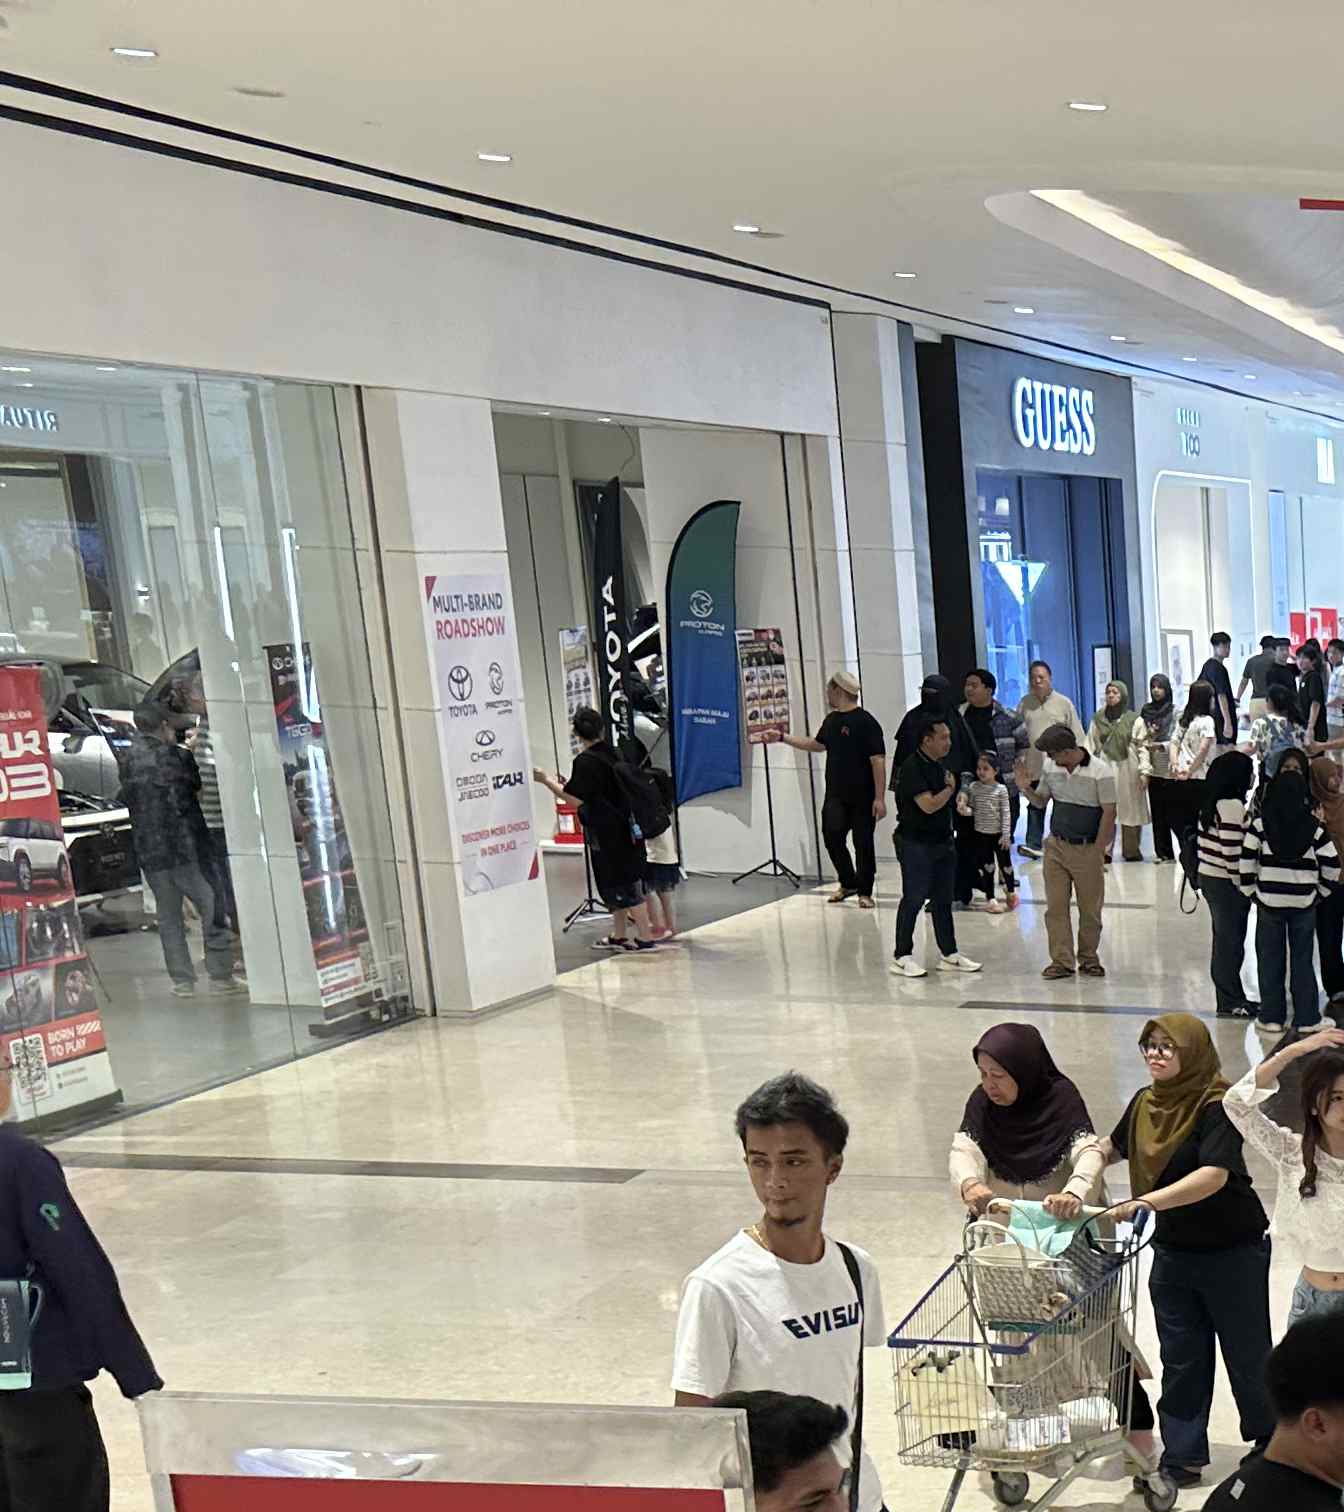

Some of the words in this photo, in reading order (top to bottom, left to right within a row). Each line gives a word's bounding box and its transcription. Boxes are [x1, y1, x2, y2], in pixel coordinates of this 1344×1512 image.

[1013, 376, 1096, 456] GUESS
[433, 593, 503, 613] MULTI-BRAND
[436, 616, 505, 640] ROADSHOW
[680, 620, 725, 631] PROTON
[601, 575, 629, 748] TOYOTA
[448, 704, 478, 718] TOYOTA
[470, 749, 503, 763] CHERY
[0, 763, 51, 803] 3
[47, 1026, 75, 1044] BORN
[51, 1044, 65, 1057] TO
[65, 1038, 87, 1054] PLAY
[781, 1302, 860, 1340] EVISU
